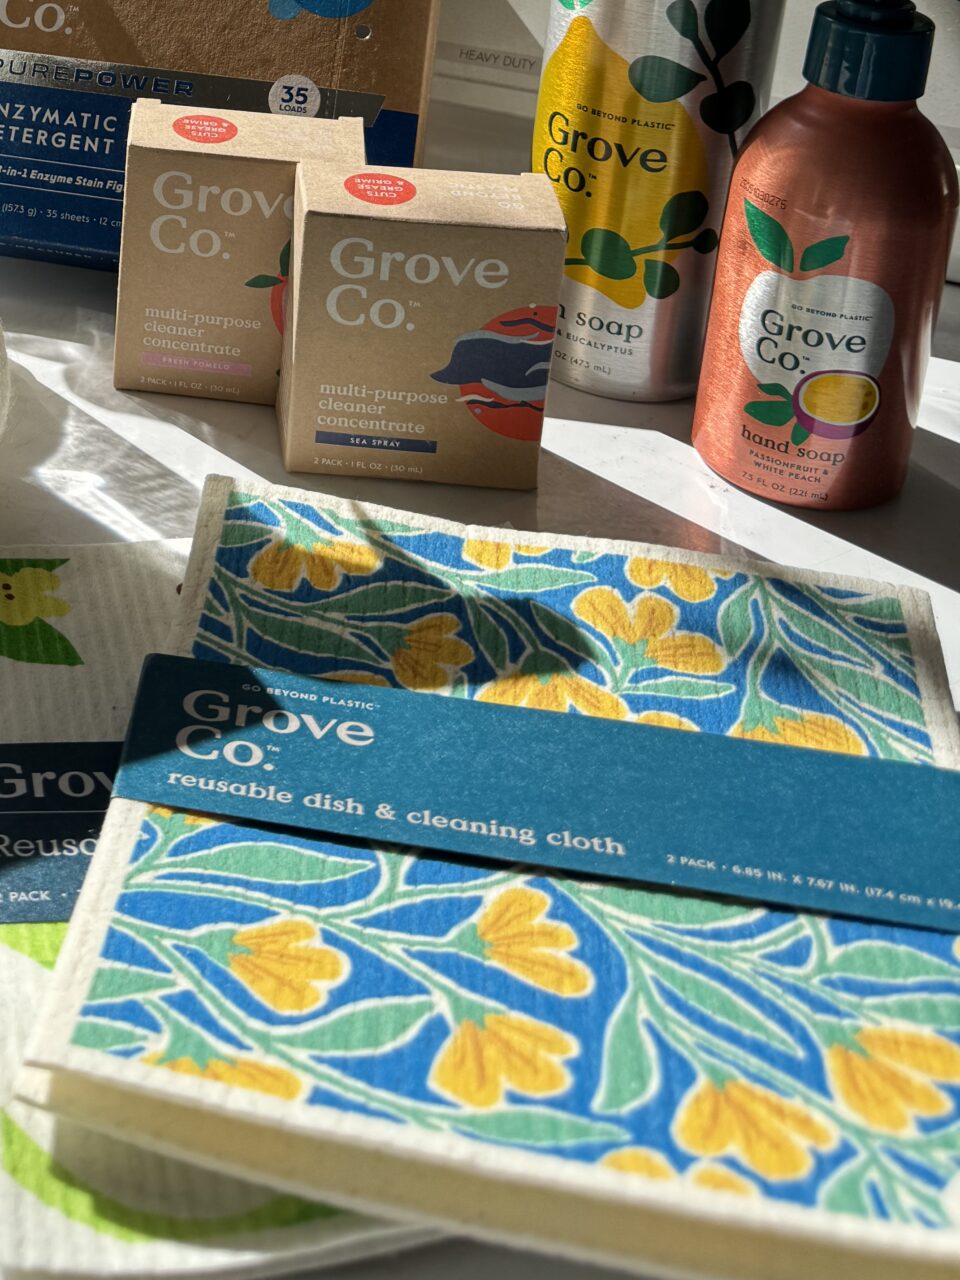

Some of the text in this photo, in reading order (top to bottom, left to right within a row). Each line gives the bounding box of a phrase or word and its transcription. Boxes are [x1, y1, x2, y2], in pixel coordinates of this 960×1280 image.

[459, 48, 536, 69] HEAVY DUTY
[281, 85, 309, 105] 35
[279, 104, 308, 113] LOADS
[576, 103, 588, 112] GO
[591, 109, 628, 123] BEYOND
[548, 111, 668, 173] Grove
[29, 170, 73, 185] Enzyme
[75, 175, 104, 190] Stain
[106, 180, 124, 193] Fig
[354, 177, 390, 185] GRIME
[358, 184, 403, 192] GREASE
[367, 190, 397, 198] CUTS
[1, 202, 24, 214] (157.3
[27, 207, 37, 216] g)
[46, 209, 58, 218] 35
[60, 212, 90, 223] sheets
[330, 237, 509, 289] Grove
[145, 307, 261, 329] multi-purpose
[791, 303, 803, 312] GO
[805, 307, 837, 318] BEYOND
[144, 320, 205, 337] cleaner
[575, 312, 643, 343] soap
[761, 309, 866, 353] Grove
[143, 336, 241, 356] concentrate
[566, 333, 633, 356] EUCALYPTUS
[193, 360, 230, 370] POMELO
[555, 350, 567, 360] OZ
[320, 383, 448, 404] multi-purpose
[318, 399, 386, 414] cleaner
[317, 415, 425, 433] concentrate
[349, 437, 400, 448] SEA SPRAY
[741, 425, 846, 466] hand soap
[313, 457, 319, 465] 2
[321, 458, 342, 467] PACK
[356, 461, 366, 469] FL
[369, 462, 383, 470] OZ
[749, 448, 819, 474] PASSIONFRUIT
[753, 460, 821, 484] WHITE PEACH
[242, 683, 262, 693] GO
[266, 687, 318, 702] BEYOND
[182, 689, 375, 747] Grove
[168, 770, 627, 857] reusable dish & cleaning cloth
[666, 854, 676, 864] 2
[680, 856, 717, 871] PACK
[732, 865, 762, 880] 6.85
[767, 871, 788, 883] IN.
[9, 890, 51, 902] PACK
